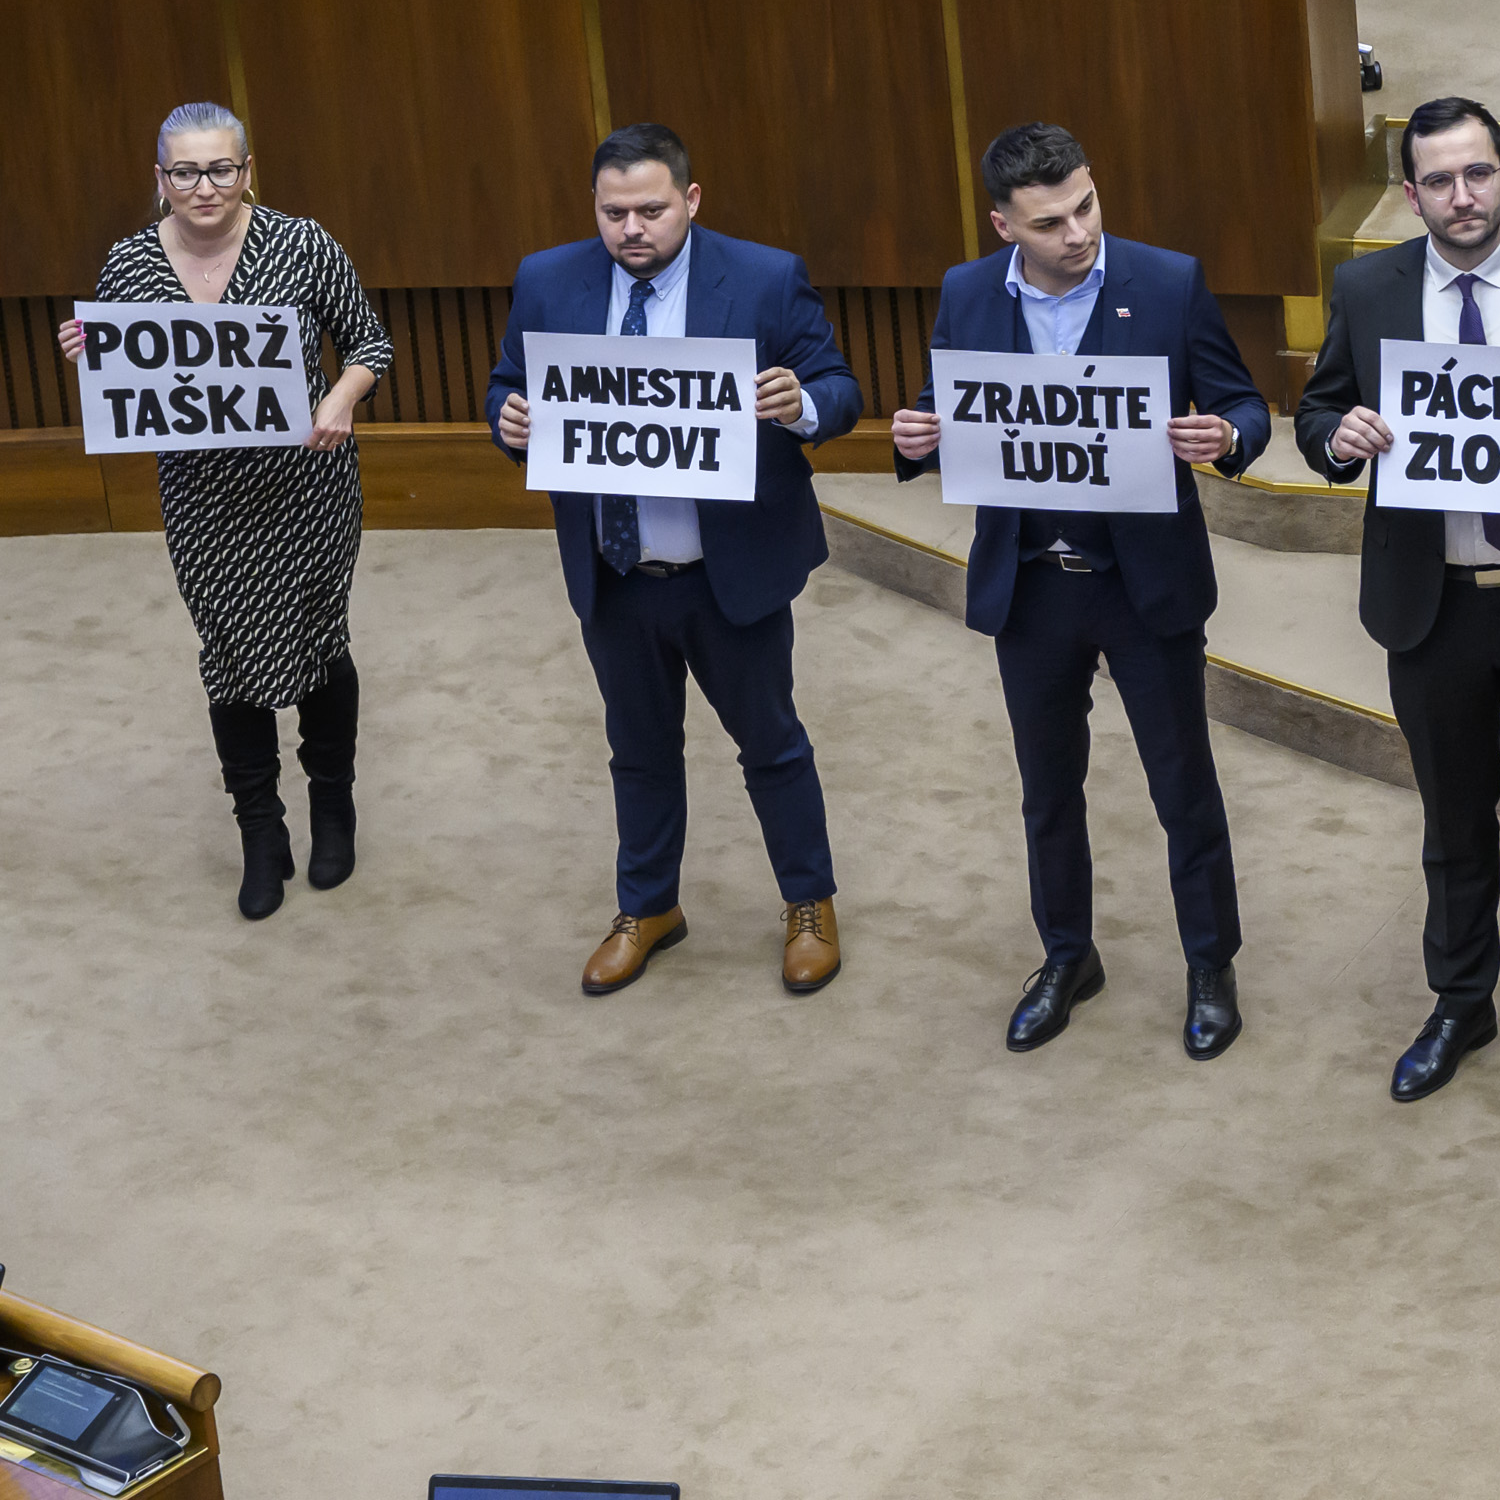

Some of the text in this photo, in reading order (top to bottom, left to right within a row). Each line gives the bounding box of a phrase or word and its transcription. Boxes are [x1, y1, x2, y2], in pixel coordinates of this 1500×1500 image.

[85, 312, 293, 371] PODRŽ
[103, 373, 290, 438] TAŠKA
[542, 365, 741, 412] AMNESTIA
[953, 365, 1152, 430] ZRADÍTE
[563, 420, 720, 471] FICOVI
[1001, 429, 1110, 486] ĽUDÍ
